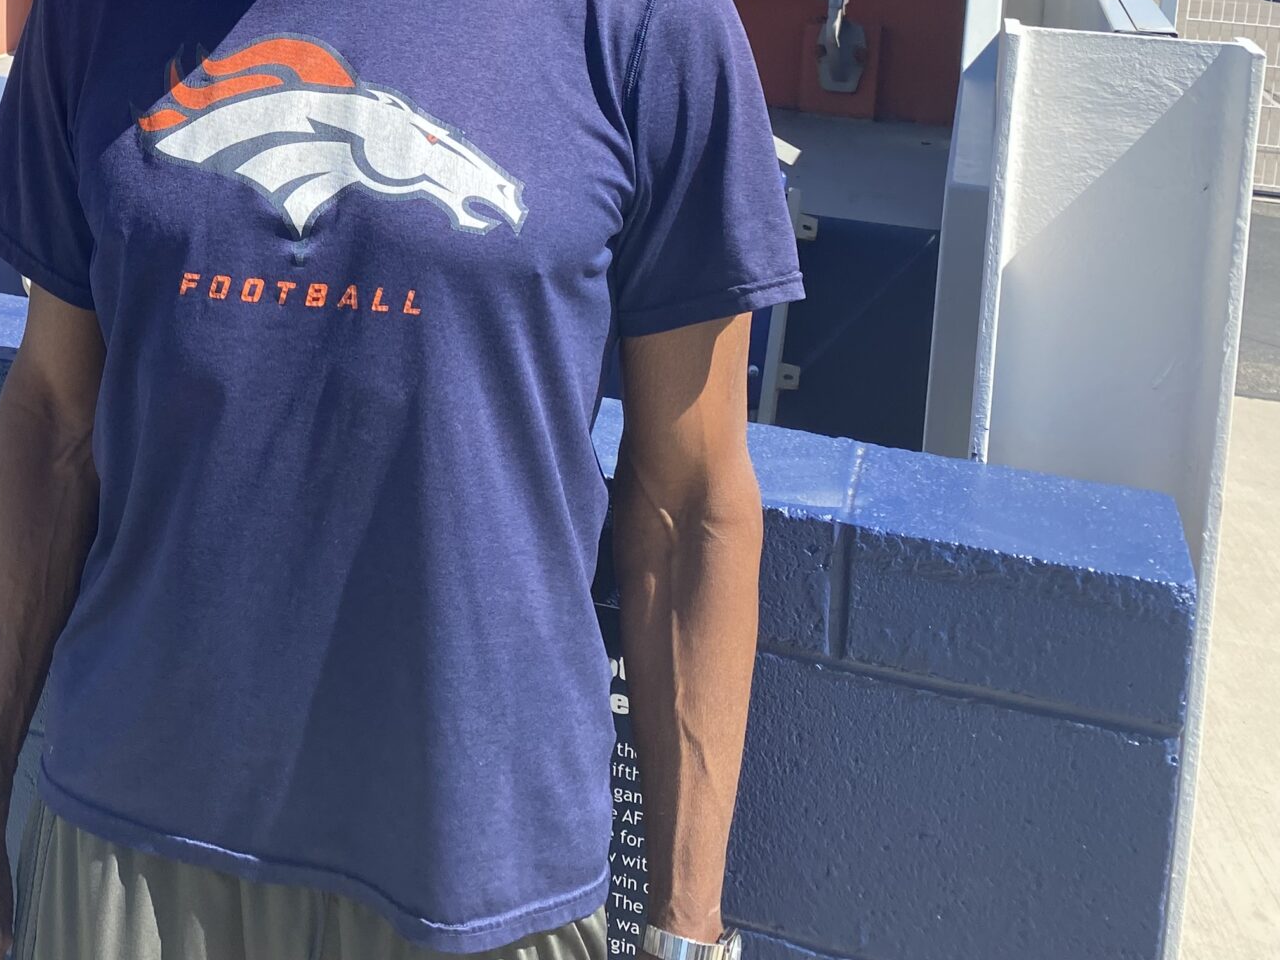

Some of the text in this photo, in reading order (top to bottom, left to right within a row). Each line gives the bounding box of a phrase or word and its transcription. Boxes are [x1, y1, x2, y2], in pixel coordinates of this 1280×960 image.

[179, 272, 421, 316] FOOTBALL
[620, 829, 645, 848] for
[612, 892, 644, 914] The
